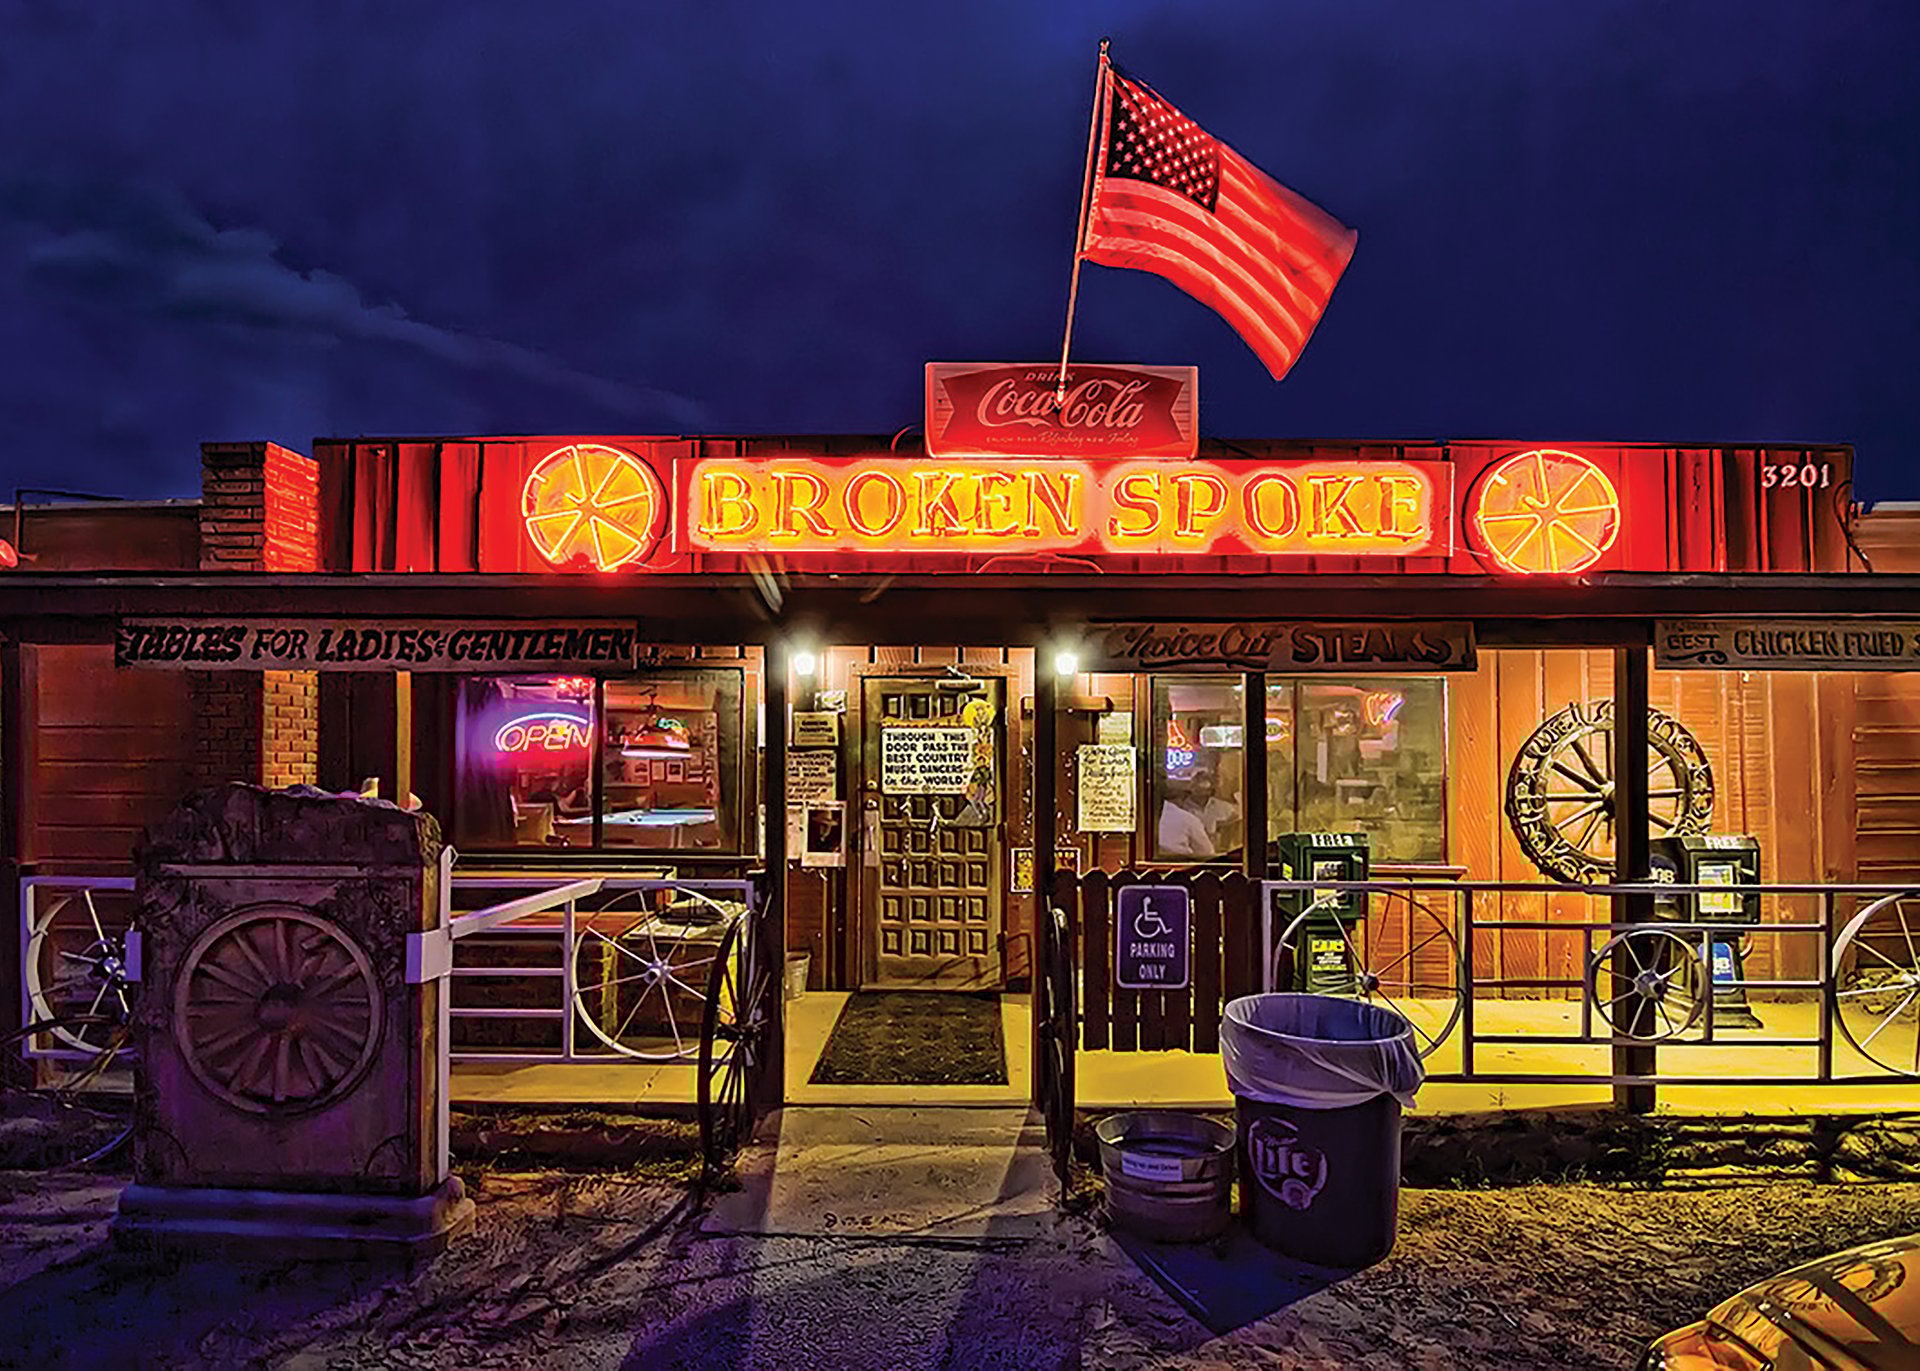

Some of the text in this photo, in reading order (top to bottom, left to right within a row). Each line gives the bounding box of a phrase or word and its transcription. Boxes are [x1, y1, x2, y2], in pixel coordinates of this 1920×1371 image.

[1762, 463, 1830, 488] 3201
[698, 472, 1425, 541] BROKEN SPOKE
[126, 625, 247, 661] TABLES
[250, 628, 308, 661] FOR
[1104, 623, 1217, 659] Choice
[1218, 622, 1283, 658] Cut
[1666, 633, 1720, 649] BEST
[1733, 630, 1840, 657] CHICKEN
[1843, 631, 1905, 657] FRIED
[502, 725, 593, 751] OPEN
[886, 732, 966, 741] THROUGH THIS
[886, 743, 969, 752] DOOR PASS THE
[886, 754, 969, 763] BEST COUNTRY
[885, 764, 964, 774] MUSIC DANCERS
[884, 776, 897, 785] in
[1311, 833, 1354, 847] FREE
[1705, 835, 1742, 850] FREE
[1129, 942, 1175, 958] PARKING
[1138, 964, 1166, 980] ONLY
